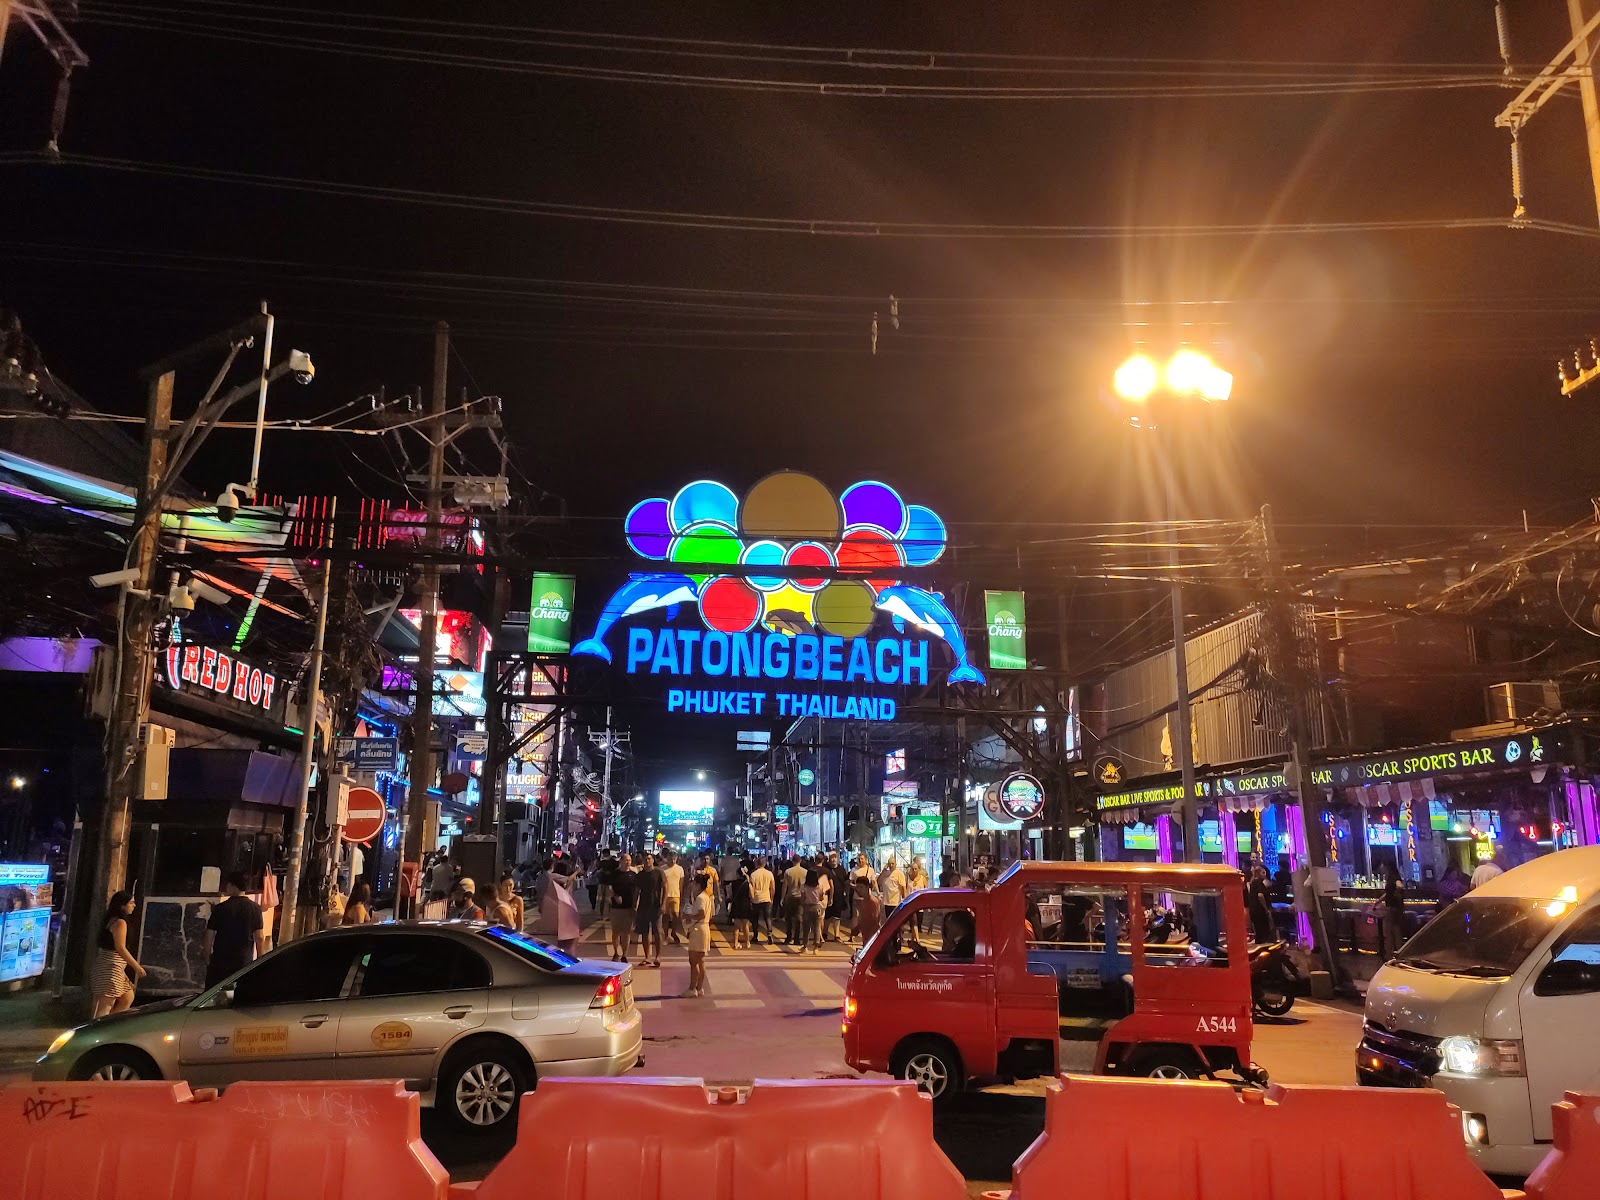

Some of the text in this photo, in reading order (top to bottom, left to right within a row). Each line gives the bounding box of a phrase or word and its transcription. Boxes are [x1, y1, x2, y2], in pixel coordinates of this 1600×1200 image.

[531, 607, 570, 622] Chang
[988, 625, 1023, 639] Chang
[182, 646, 275, 710] RED HOT
[667, 689, 896, 721] PHUKET THAILAND
[1357, 747, 1496, 779] OSCAR SPORTS BAR
[1239, 778, 1270, 791] OSCAR
[1103, 797, 1120, 808] OSCAR
[1120, 795, 1131, 806] BAR
[1131, 793, 1143, 805] LIVE
[1143, 789, 1165, 803] SPORTS
[1165, 789, 1171, 800] &
[1171, 786, 1185, 800] POO
[1328, 812, 1338, 862] SCAR
[1195, 1016, 1236, 1033] A544
[380, 1030, 411, 1039] 1584
